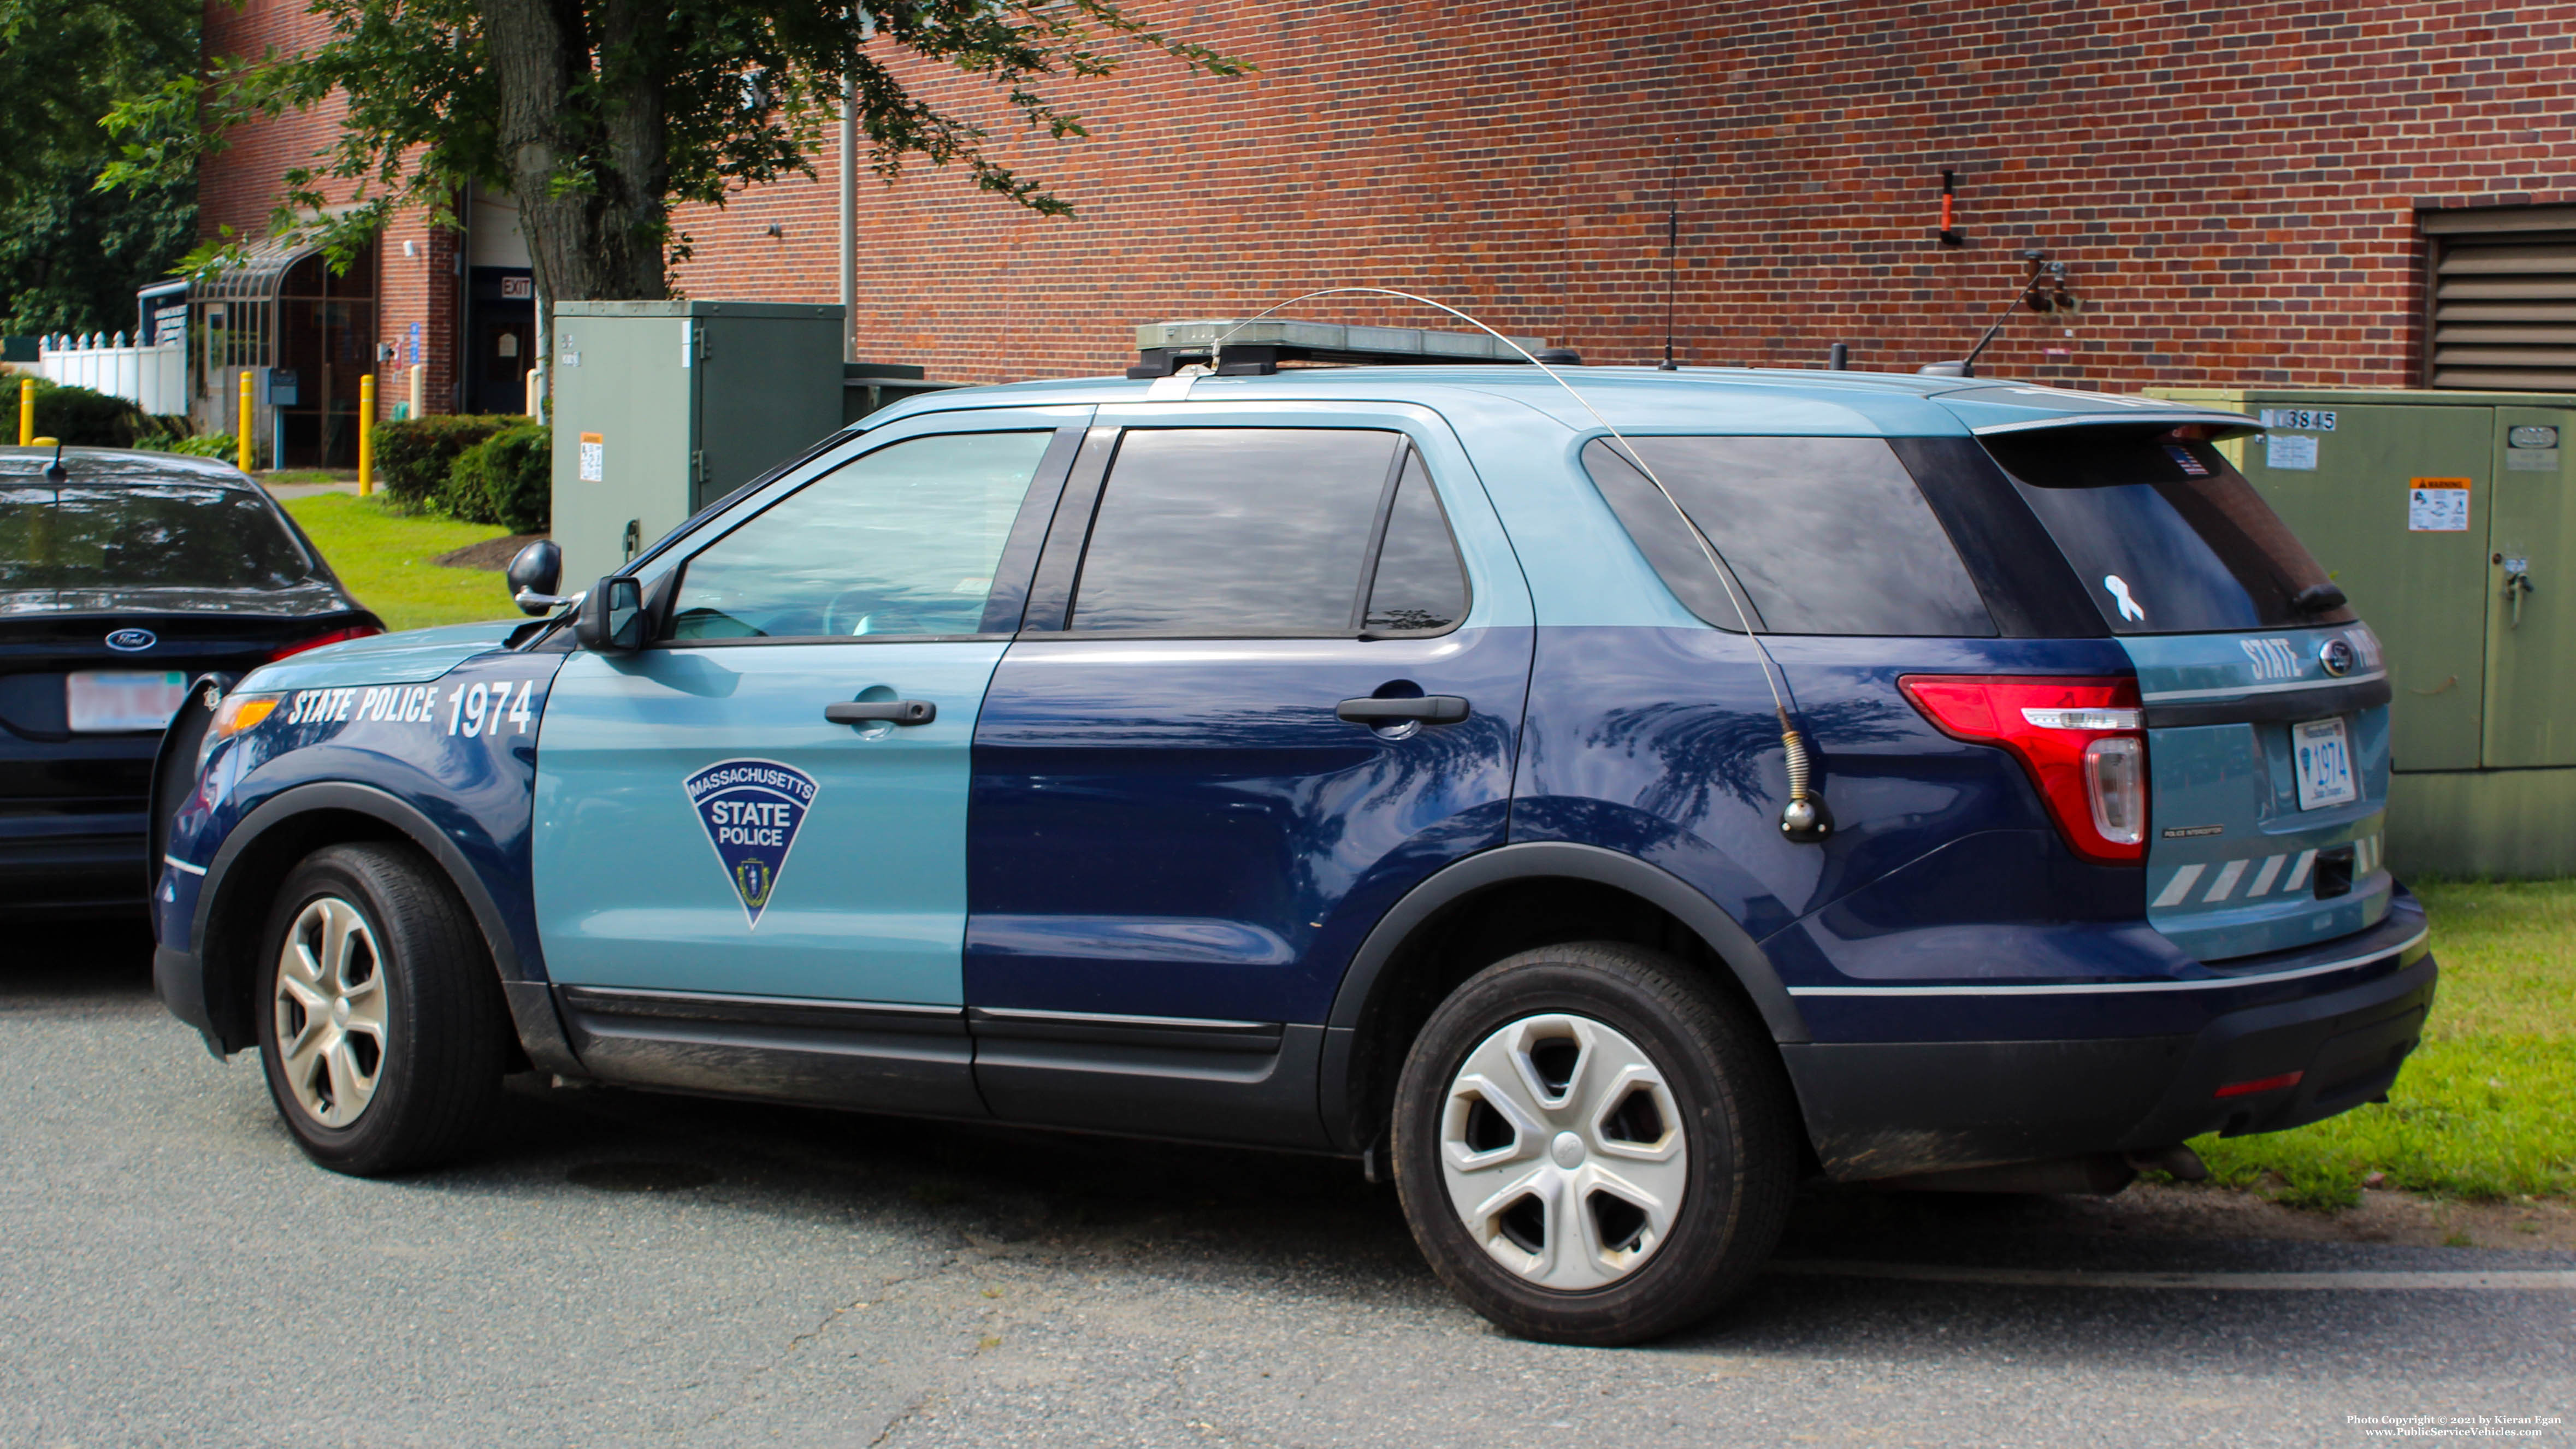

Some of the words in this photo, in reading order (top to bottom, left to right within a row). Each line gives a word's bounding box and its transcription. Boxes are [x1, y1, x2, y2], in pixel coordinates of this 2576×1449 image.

[504, 279, 530, 295] EXIT
[2287, 410, 2335, 429] 3845
[116, 632, 146, 645] Ford
[2240, 637, 2303, 680] STATE
[287, 688, 357, 725] STATE
[356, 686, 439, 723] POLICE
[447, 679, 534, 738] 1974
[2313, 741, 2348, 786] 1974
[689, 767, 814, 800] MASSACHUSETTS
[711, 800, 791, 827] STATE
[719, 827, 783, 847] POLICE
